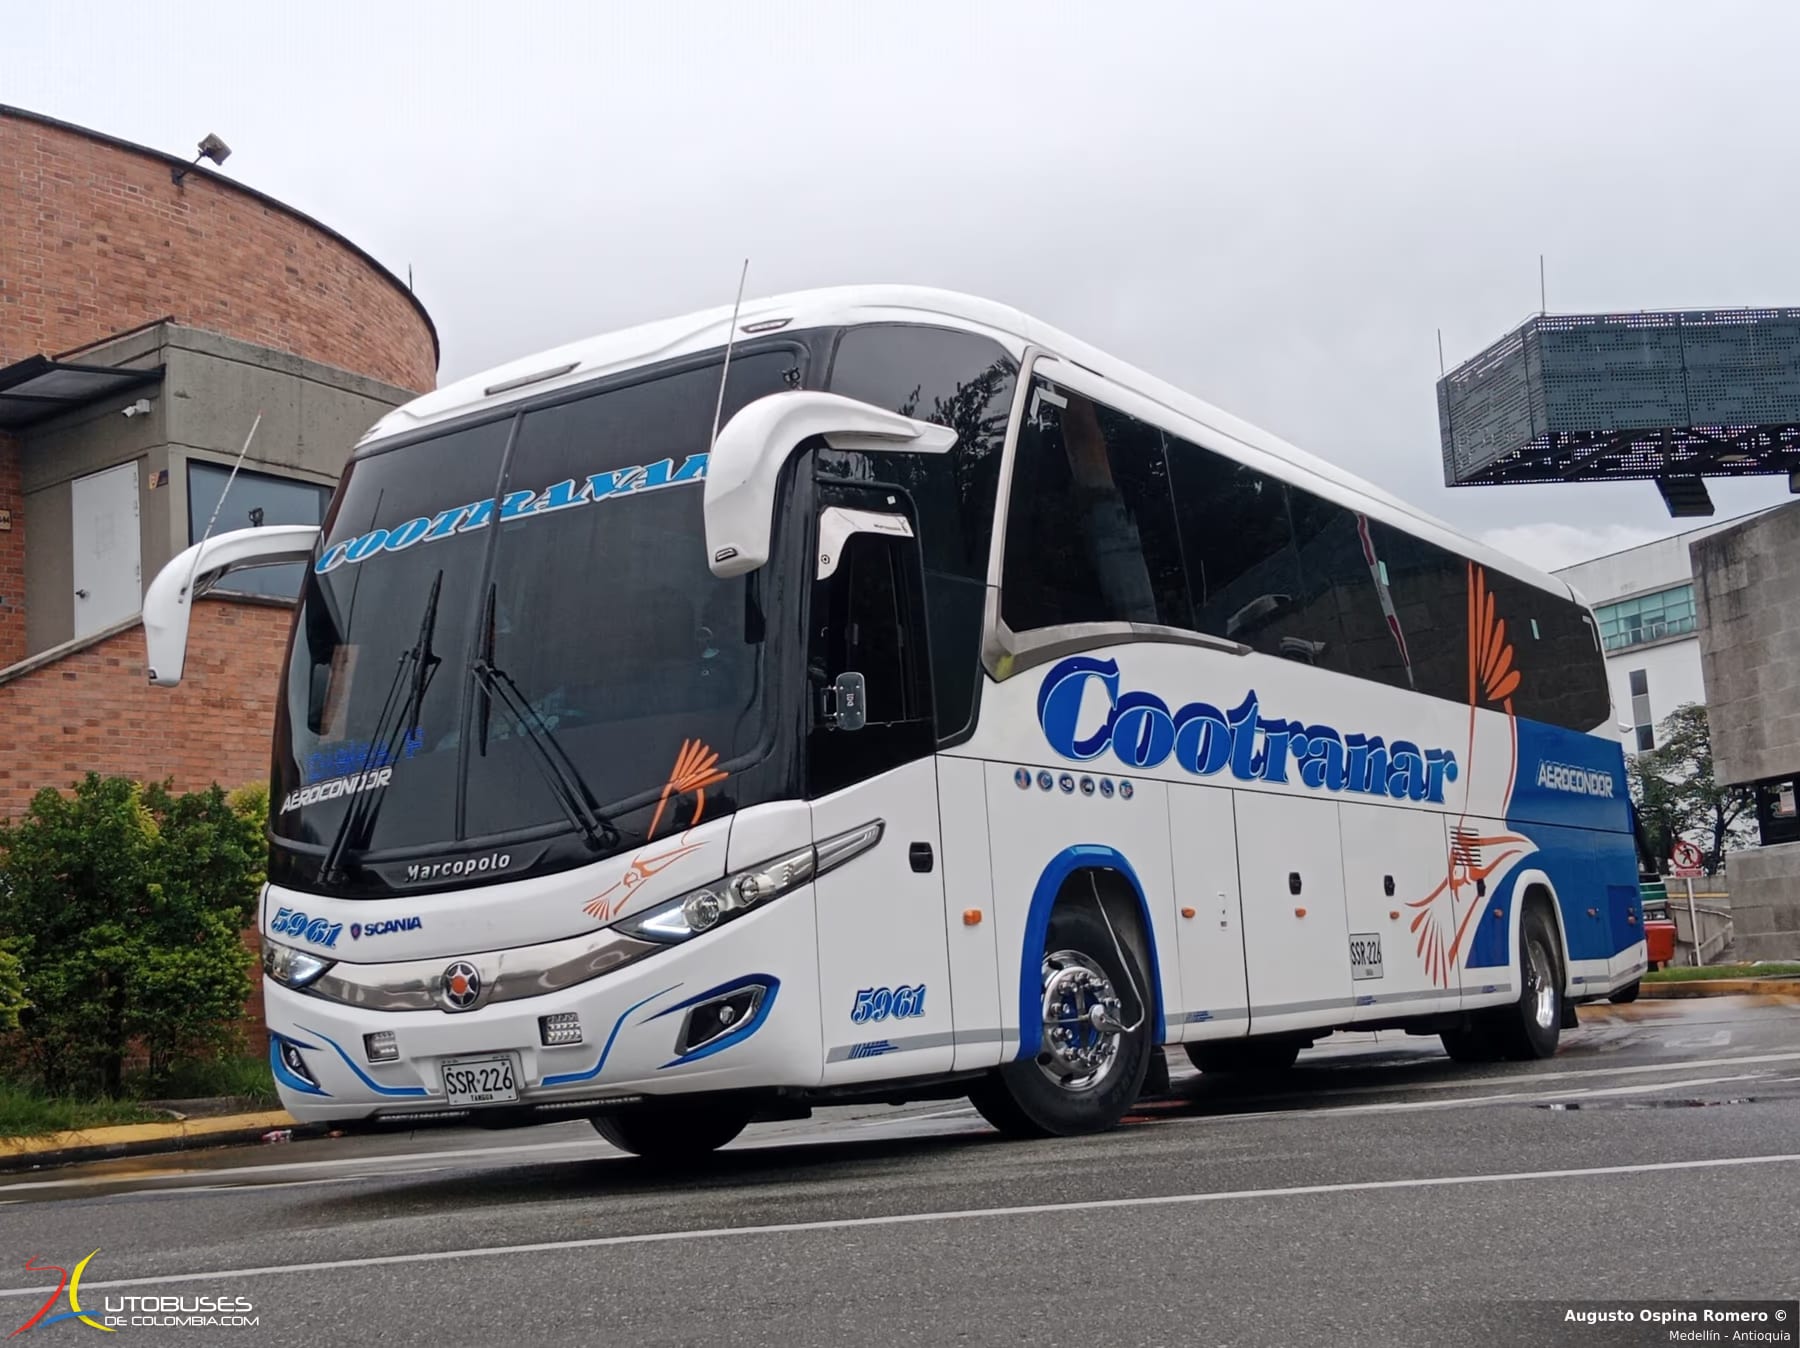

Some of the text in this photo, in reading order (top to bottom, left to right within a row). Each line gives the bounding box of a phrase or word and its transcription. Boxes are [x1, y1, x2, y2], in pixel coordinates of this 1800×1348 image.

[1037, 656, 1458, 804] Cootranar
[1536, 759, 1614, 799] AEROCONDOR
[404, 853, 511, 882] Marcopolo
[271, 906, 343, 950] 5961
[364, 916, 422, 937] SCANIA
[850, 983, 926, 1025] 5961
